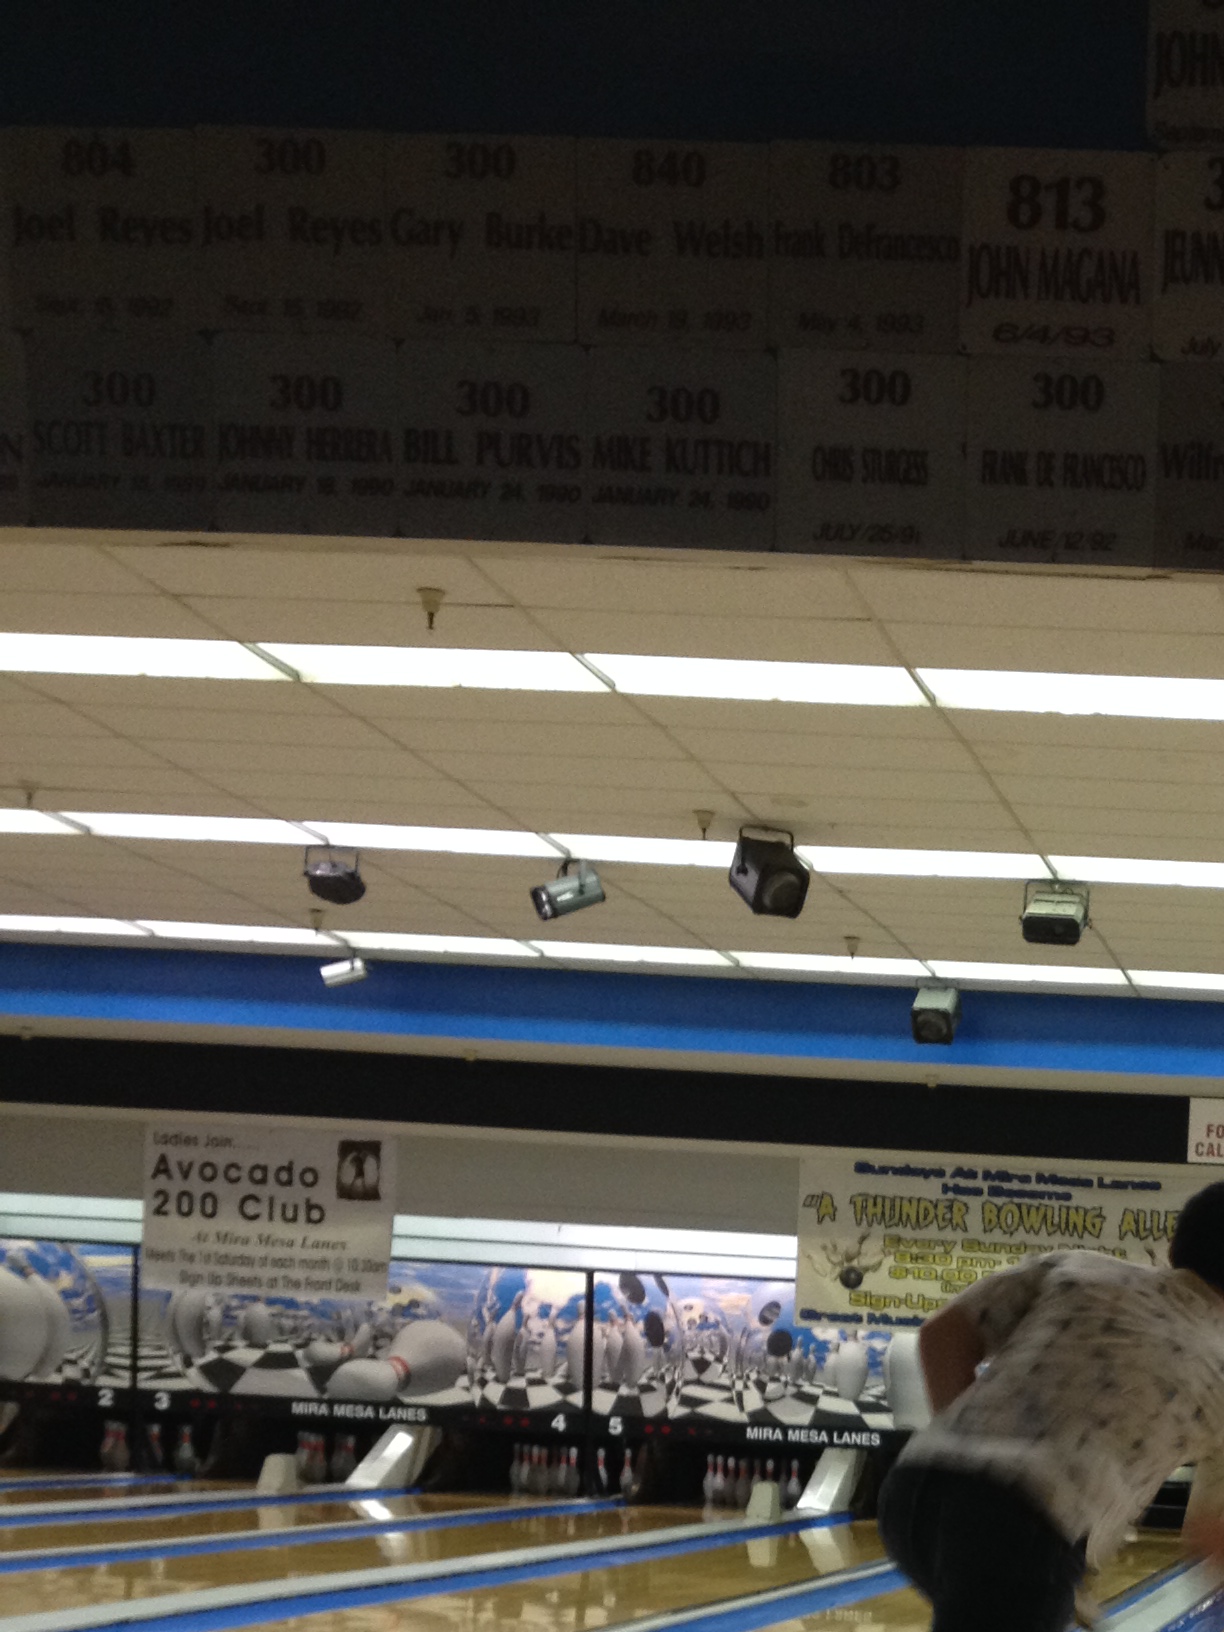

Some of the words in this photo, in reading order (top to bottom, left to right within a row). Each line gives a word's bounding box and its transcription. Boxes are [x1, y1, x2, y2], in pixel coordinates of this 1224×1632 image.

[61, 137, 136, 178] 804
[256, 137, 326, 176] 300
[445, 141, 516, 180] 300
[632, 149, 707, 188] 840
[828, 153, 901, 192] 803
[1007, 174, 1107, 233] 813
[13, 204, 76, 248] Joel
[97, 206, 193, 247] Reyes
[202, 203, 265, 247] Joel
[287, 206, 382, 256] Reyes
[390, 208, 464, 260] Gary
[485, 211, 573, 250] Burke
[579, 217, 652, 257] Dave
[966, 242, 1030, 308] JOHN
[1038, 246, 1142, 305] MAGANA
[991, 322, 1116, 348] 6/4/93
[1181, 337, 1222, 359] July
[82, 370, 156, 408] 300
[269, 373, 343, 412] 300
[456, 379, 530, 418] 300
[646, 385, 721, 424] 300
[838, 368, 911, 407] 300
[1031, 372, 1105, 412] 300
[32, 419, 108, 456] SCOTT
[402, 428, 461, 467] BILL
[476, 430, 582, 471] PURVIS
[591, 434, 653, 473] MIKE
[150, 1152, 320, 1189] Avocado
[152, 1187, 219, 1220] 200
[238, 1193, 327, 1225] Club
[850, 1192, 969, 1234] THUNDER
[982, 1201, 1106, 1240] BOWLING
[1118, 1207, 1181, 1242] ALLE
[154, 1391, 171, 1410] 3
[291, 1402, 329, 1418] MIRA
[332, 1403, 376, 1420] MESA
[378, 1405, 427, 1422] LANES
[551, 1414, 568, 1432] 4
[608, 1417, 624, 1436] 5
[746, 1426, 784, 1442] MIRA
[787, 1428, 829, 1444] MESA
[833, 1430, 882, 1447] LANES
